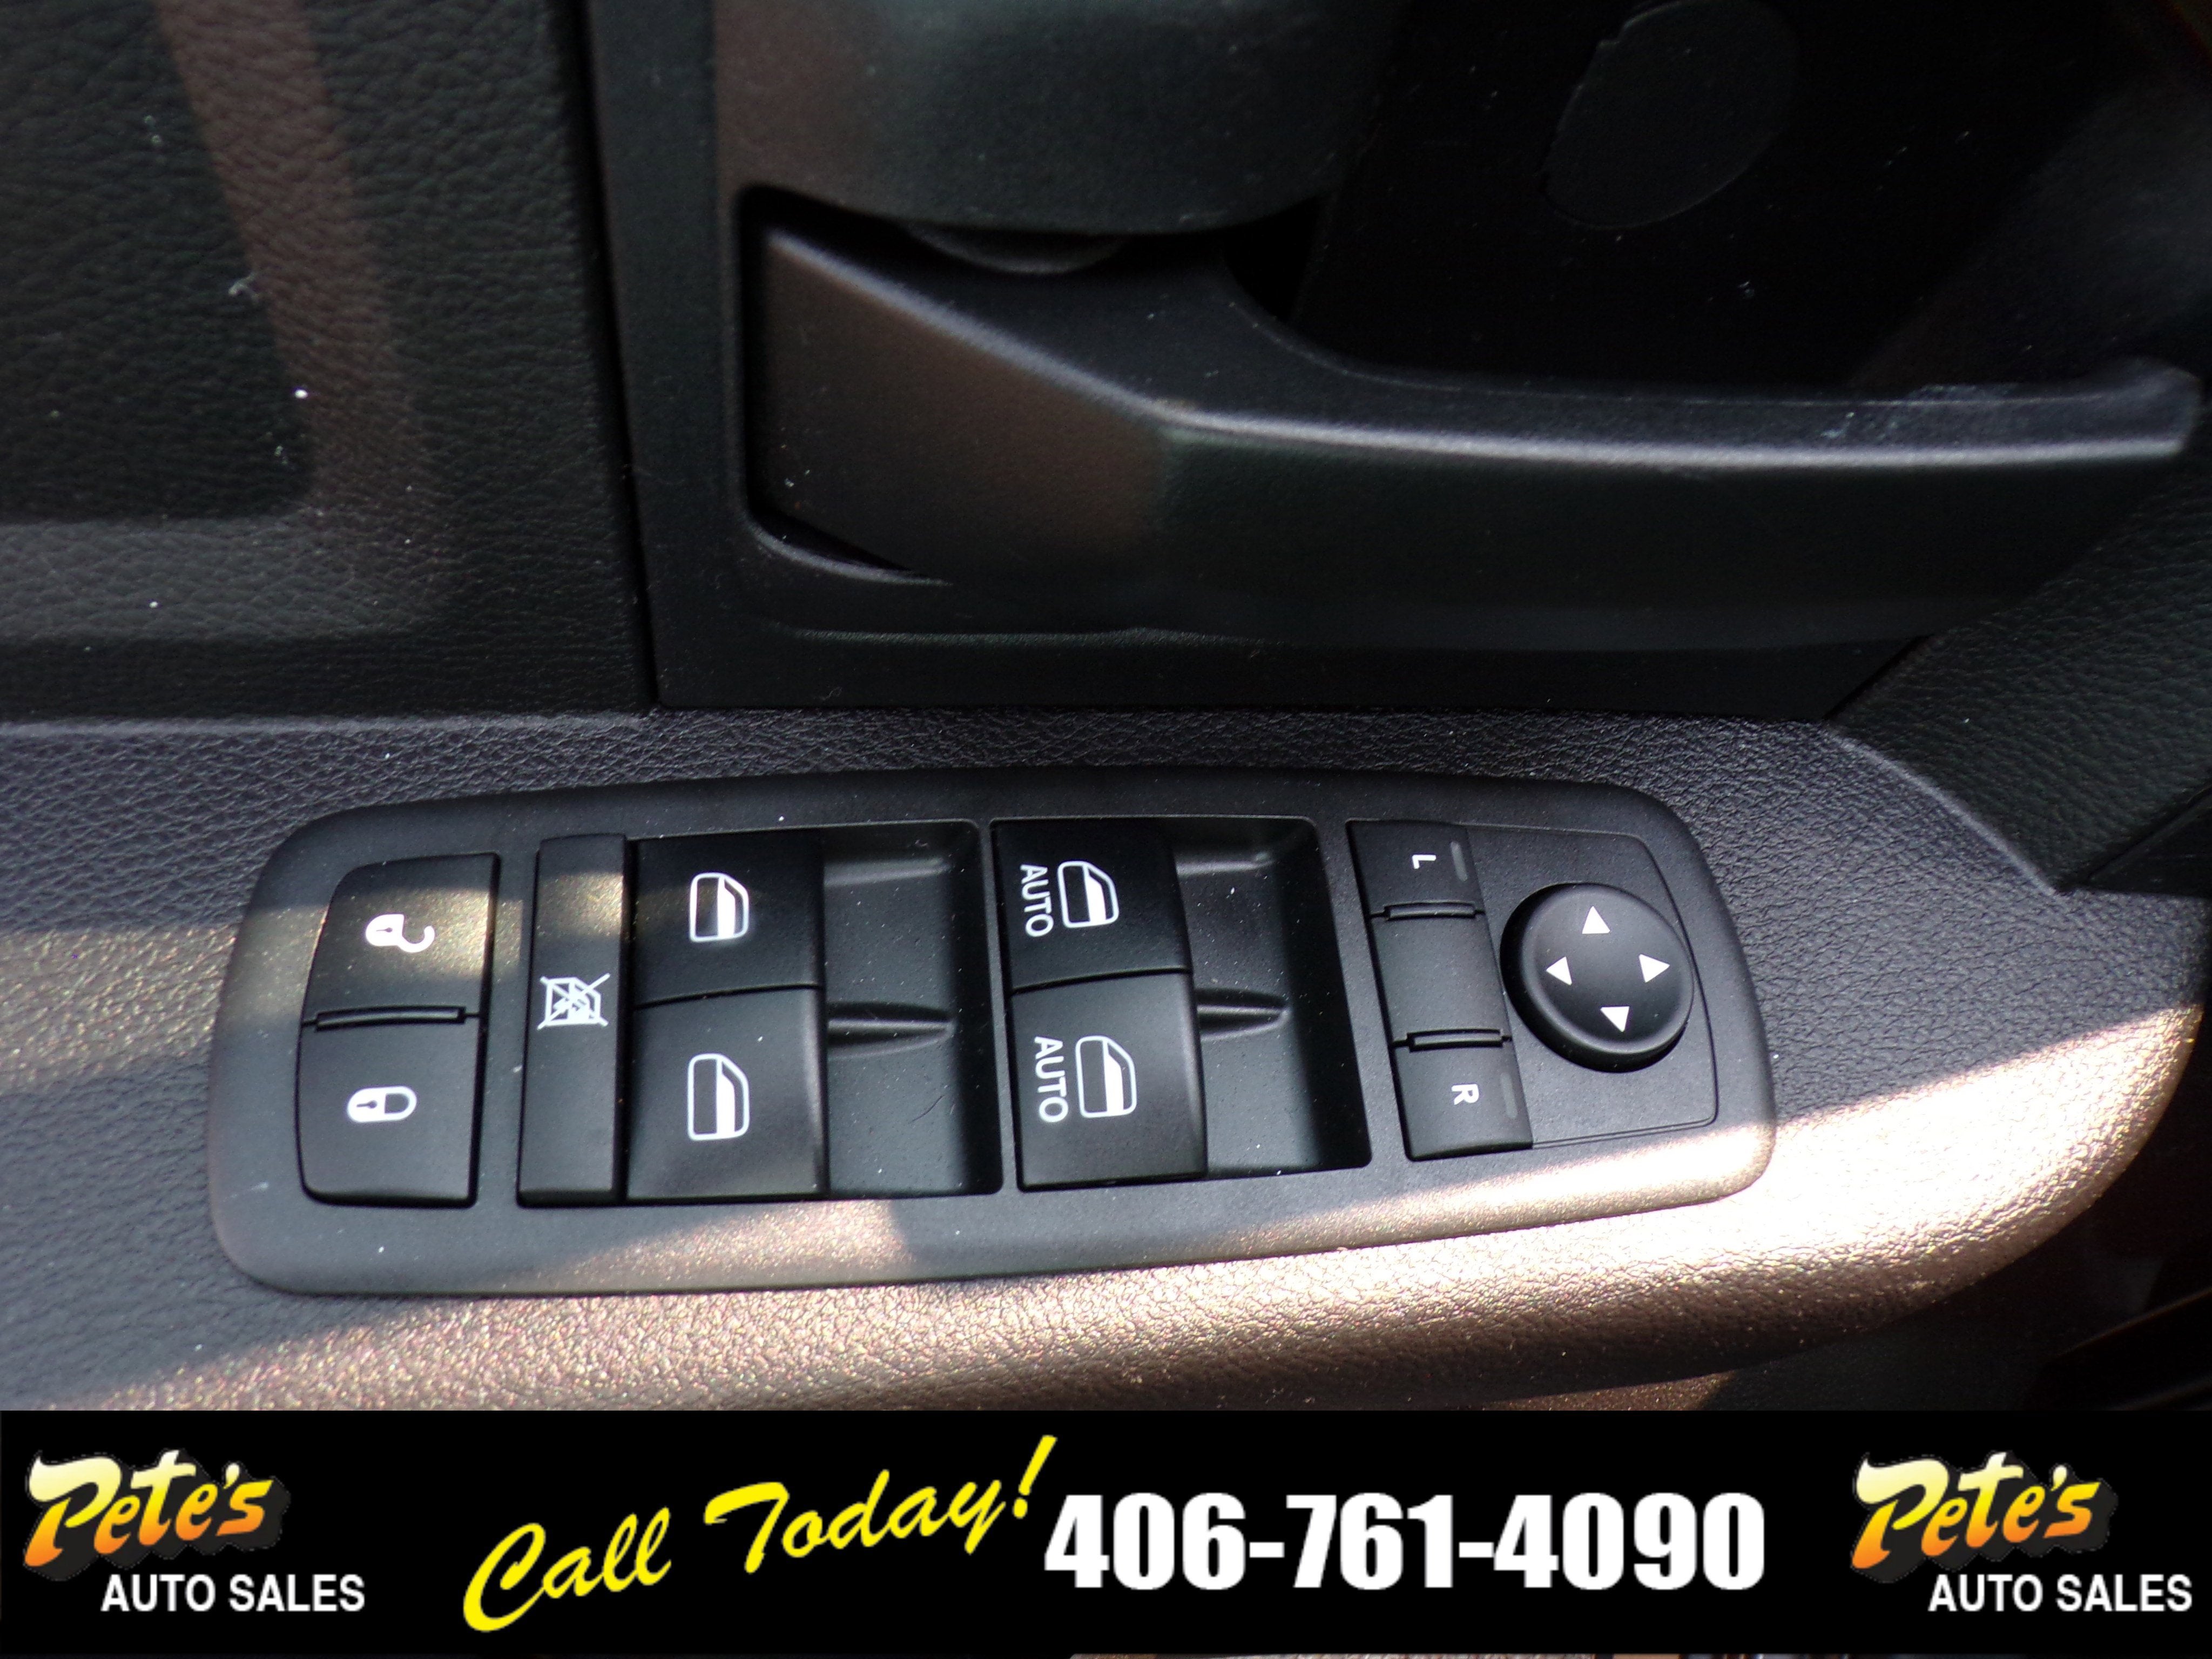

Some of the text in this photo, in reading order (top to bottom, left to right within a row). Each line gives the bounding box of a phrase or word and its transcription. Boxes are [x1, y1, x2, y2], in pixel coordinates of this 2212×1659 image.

[1412, 854, 1437, 869] L
[1021, 865, 1054, 937] AUTO
[1034, 1036, 1069, 1124] AUTO
[1451, 1083, 1480, 1105] R
